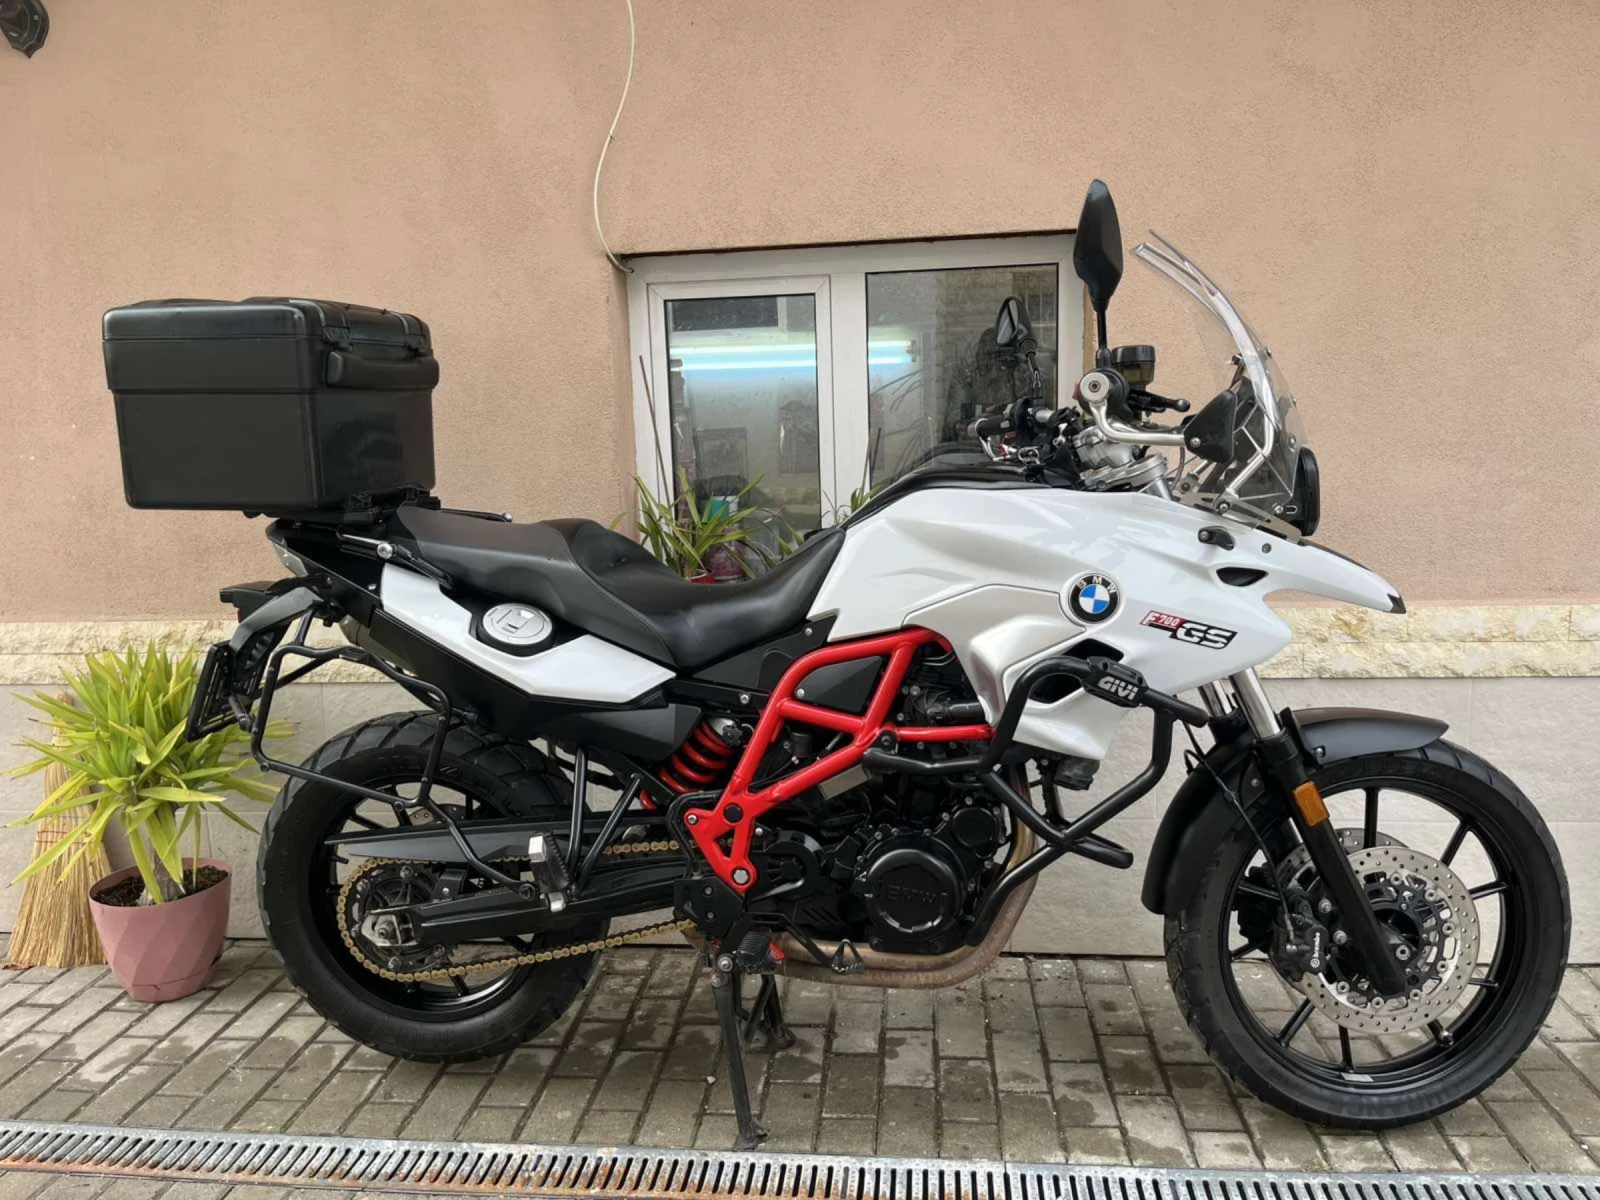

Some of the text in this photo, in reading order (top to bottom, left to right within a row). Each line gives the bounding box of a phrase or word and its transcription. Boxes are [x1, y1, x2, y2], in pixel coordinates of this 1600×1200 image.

[1076, 576, 1117, 594] BMW
[1176, 622, 1233, 648] GS
[1098, 676, 1139, 700] GIVI
